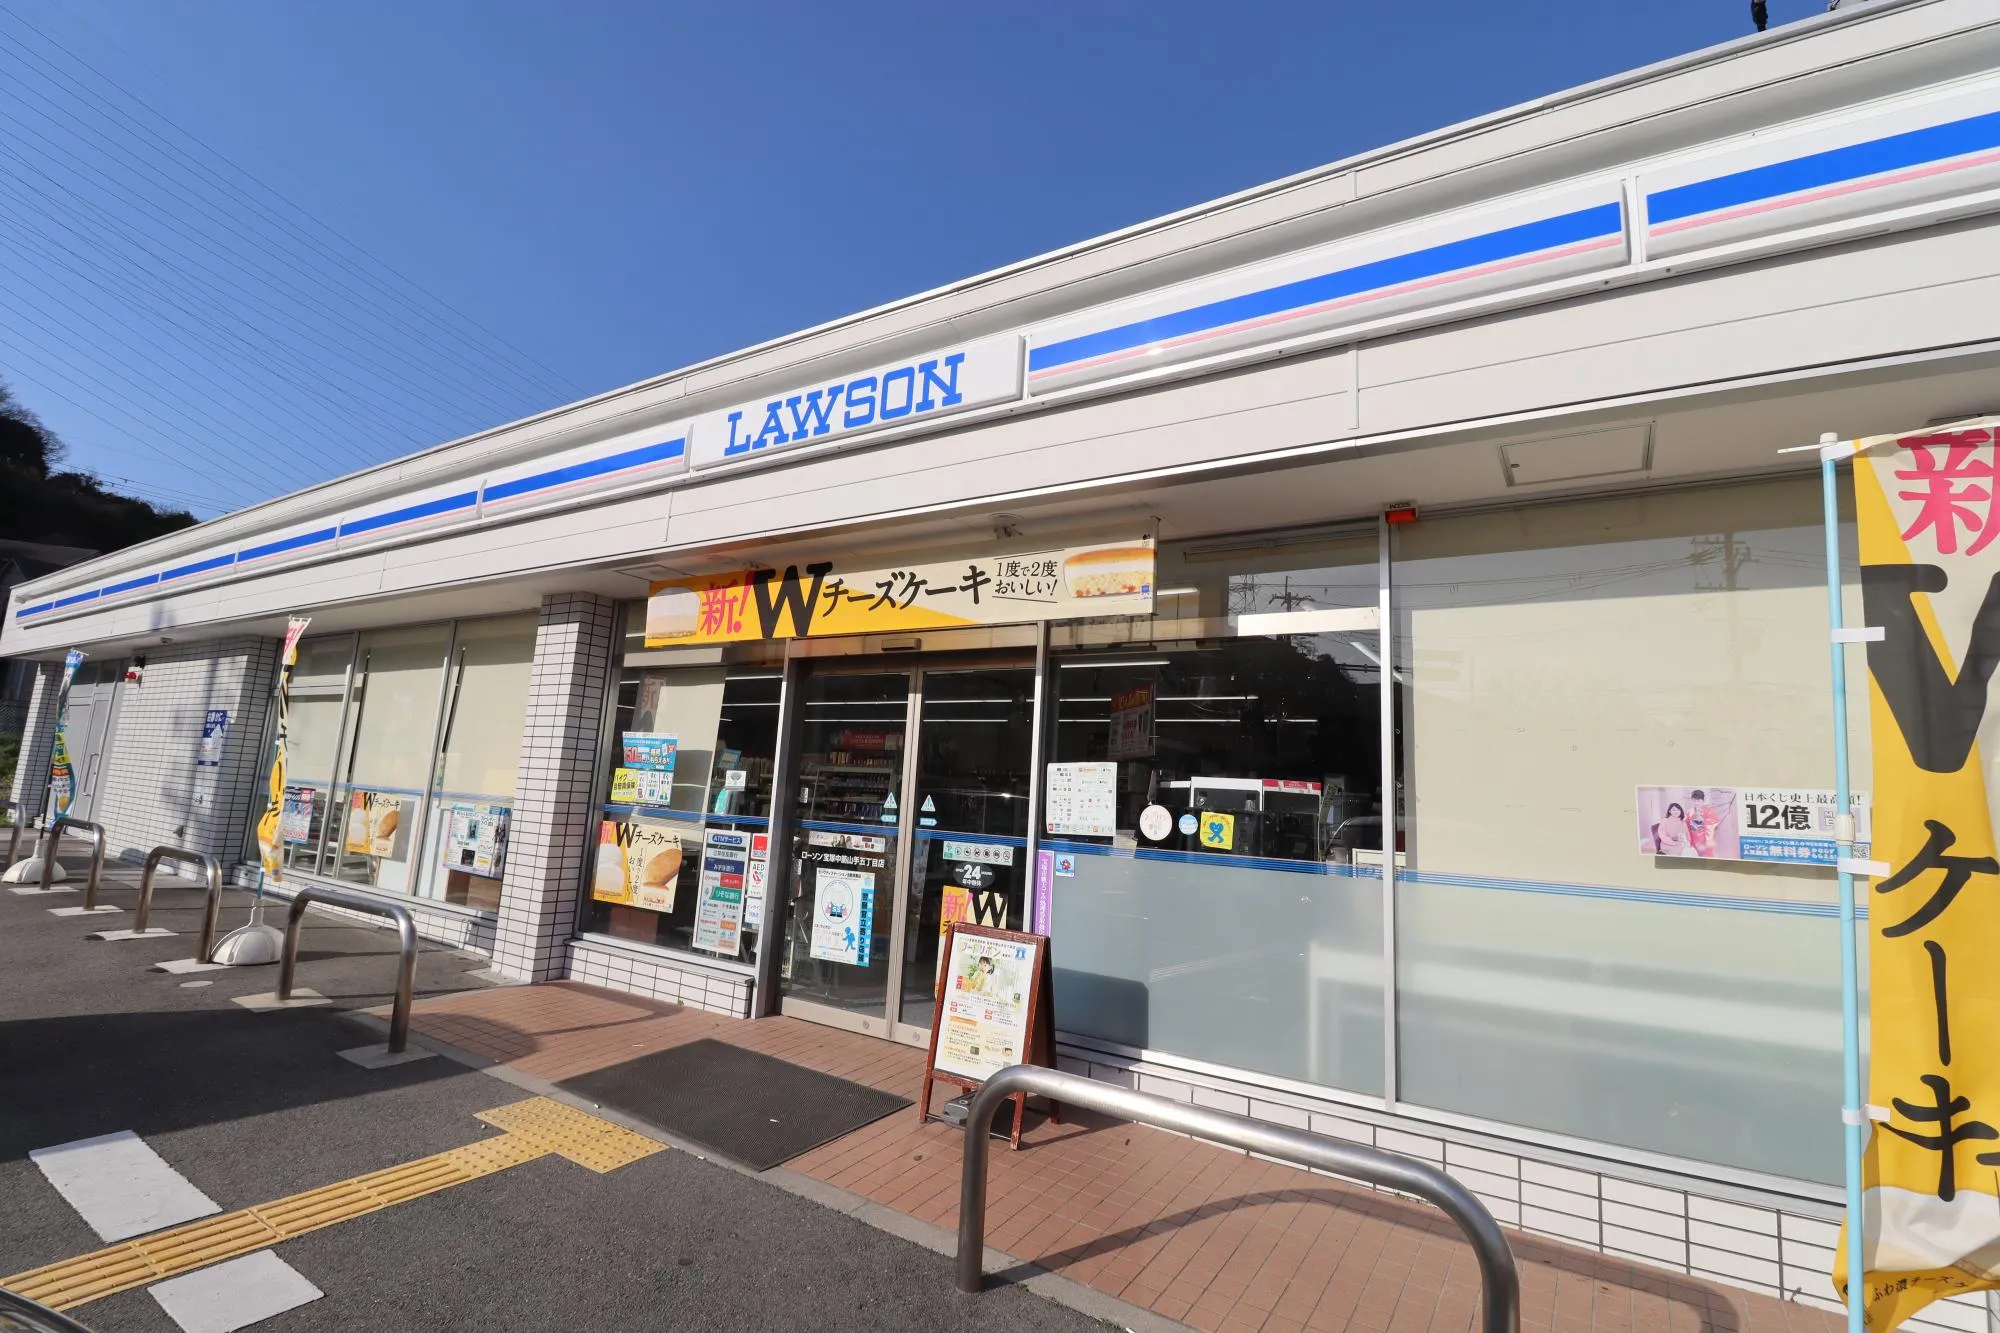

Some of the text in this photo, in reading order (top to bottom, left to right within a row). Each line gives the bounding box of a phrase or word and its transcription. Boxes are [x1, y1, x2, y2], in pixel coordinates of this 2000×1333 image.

[724, 352, 965, 456] LAWSON
[996, 560, 1058, 578] 1度で2度
[995, 579, 1058, 596] おいしい!
[1744, 792, 1862, 806] 日本くじ史上最高!
[1746, 804, 1811, 830] 12億
[752, 862, 765, 871] AED
[963, 864, 981, 880] 24
[1875, 820, 2000, 1202] ケーキ
